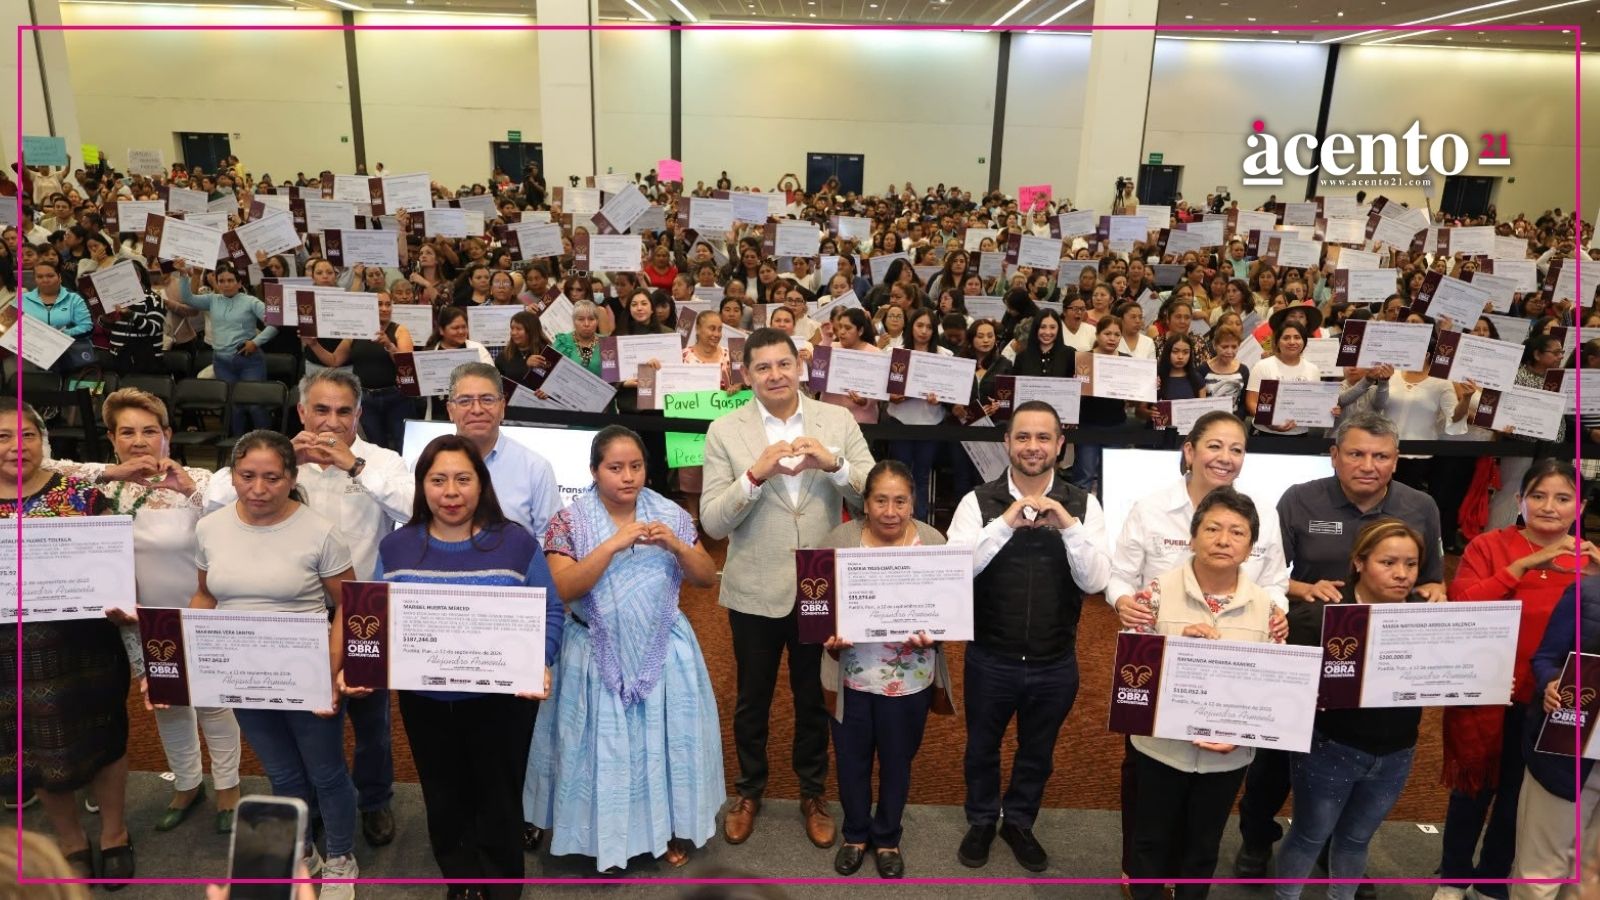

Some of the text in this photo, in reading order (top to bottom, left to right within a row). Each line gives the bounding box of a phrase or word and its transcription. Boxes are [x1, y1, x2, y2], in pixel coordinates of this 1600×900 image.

[664, 393, 700, 410] Pavel
[348, 645, 380, 653] OBRA
[150, 666, 179, 674] OBRA
[1324, 665, 1355, 674] OBRA
[1117, 692, 1149, 701] OBRA
[1552, 711, 1585, 723] OBRA
